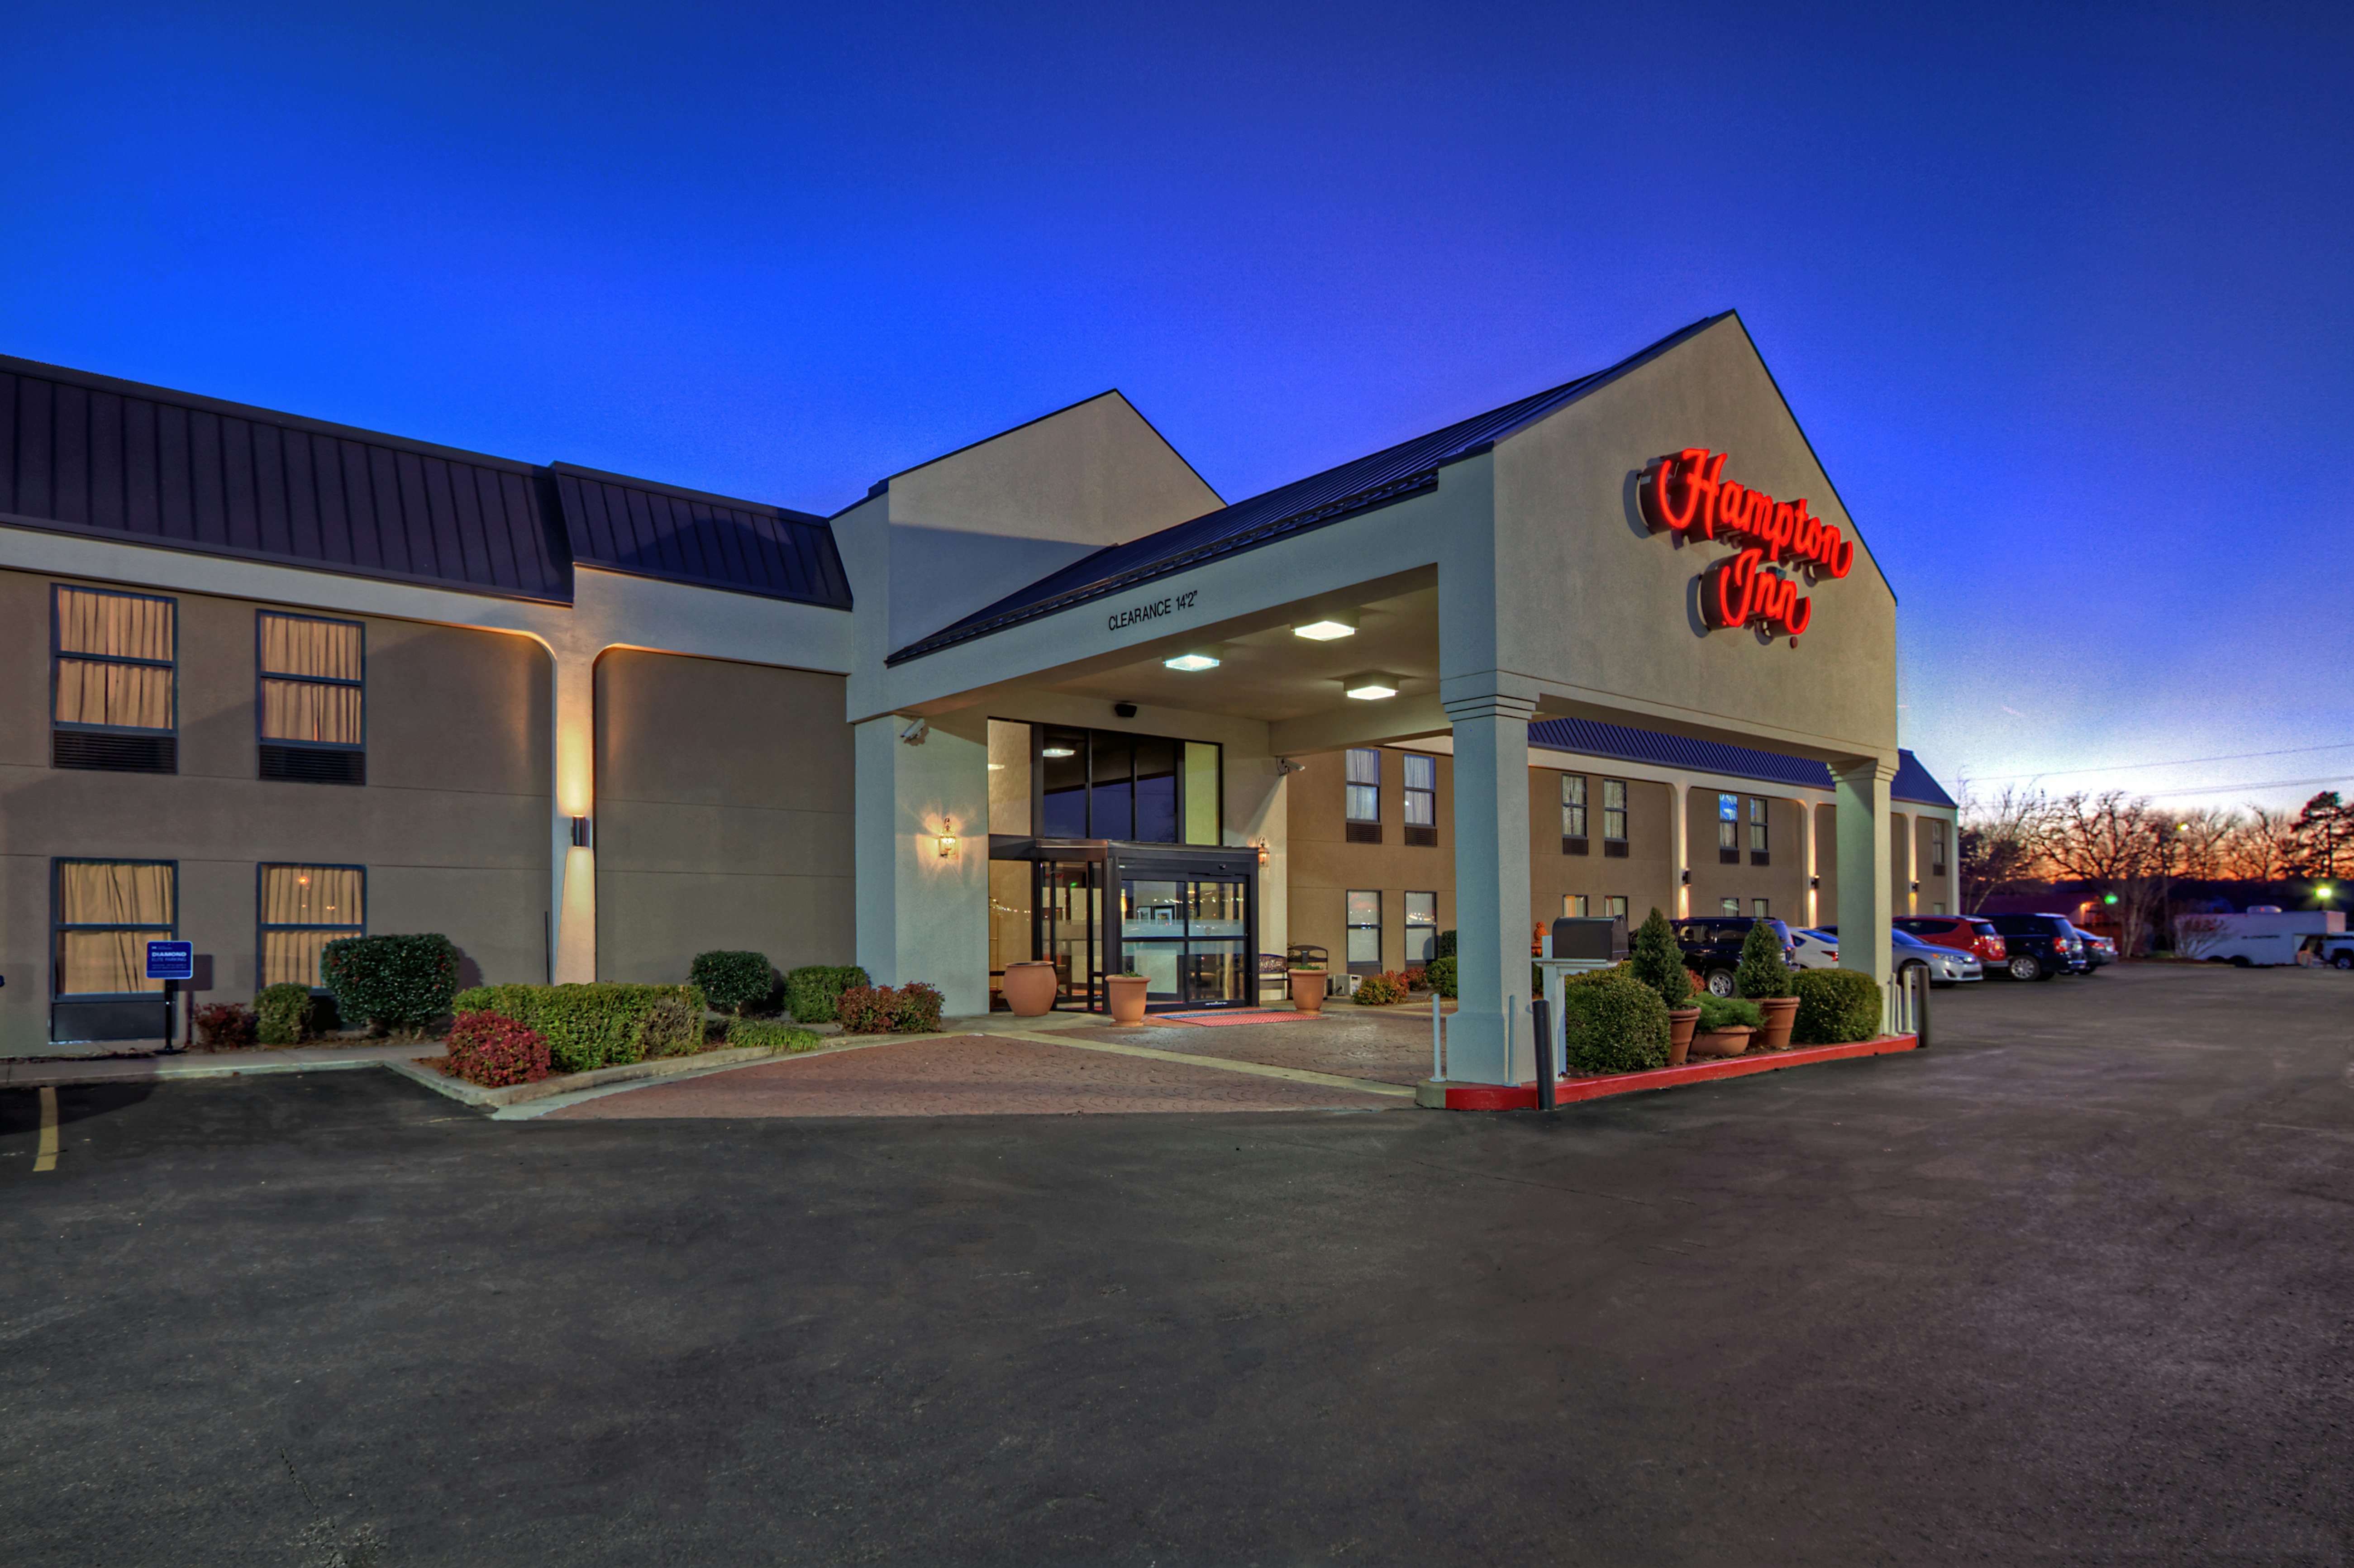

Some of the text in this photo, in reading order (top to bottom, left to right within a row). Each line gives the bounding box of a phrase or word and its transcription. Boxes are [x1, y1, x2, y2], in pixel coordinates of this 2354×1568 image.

[1659, 448, 1853, 578] Hampton
[1109, 598, 1172, 630] CLEARANCE
[1720, 548, 1811, 634] Inn
